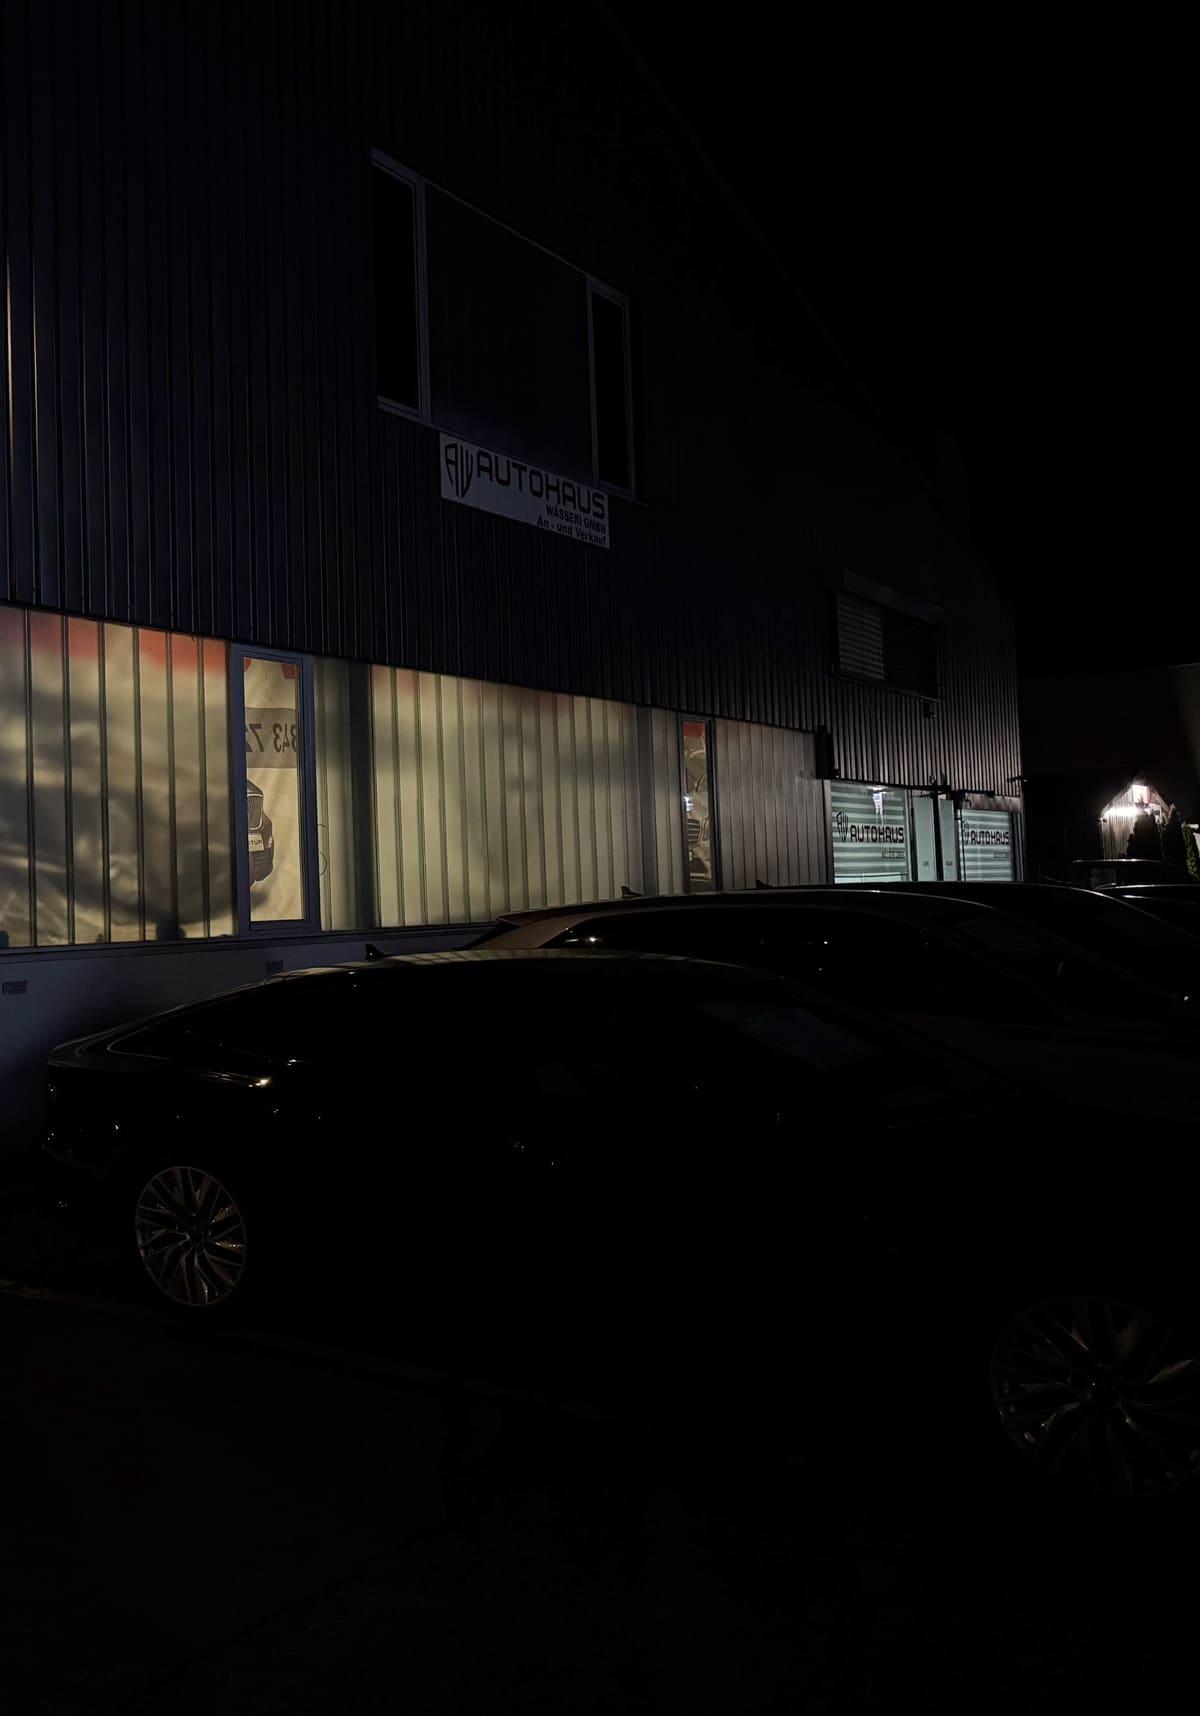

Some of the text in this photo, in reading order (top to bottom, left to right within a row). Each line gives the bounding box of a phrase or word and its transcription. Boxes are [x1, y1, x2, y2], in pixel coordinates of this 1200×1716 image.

[477, 450, 605, 519] AUTOHAUS
[557, 523, 573, 535] und
[575, 527, 606, 545] Verkauf
[583, 517, 606, 535] GMBH
[850, 825, 905, 843] AUTOHAUS
[970, 830, 1010, 845] AUTOHAUS
